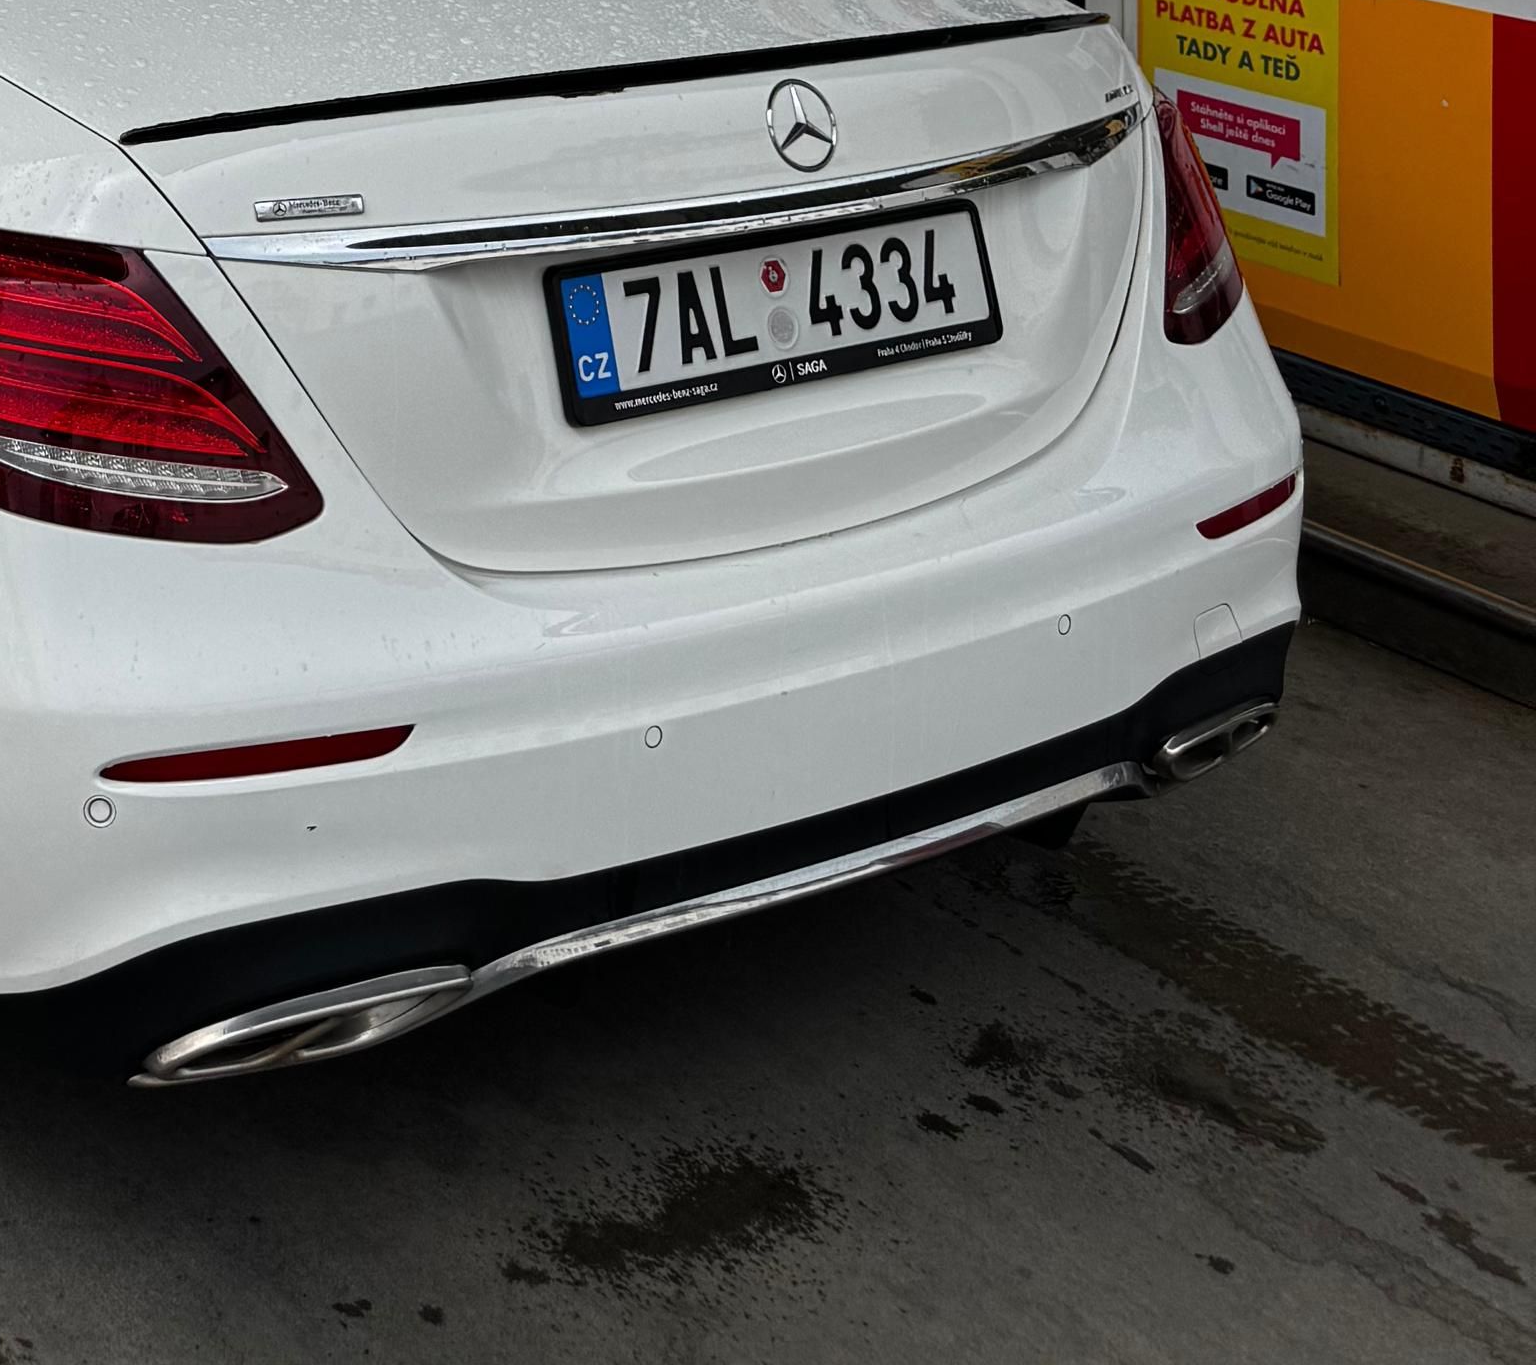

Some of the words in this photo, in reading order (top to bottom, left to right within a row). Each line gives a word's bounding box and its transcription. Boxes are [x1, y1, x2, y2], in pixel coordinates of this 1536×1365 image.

[1155, 0, 1235, 35] PLATBA
[1242, 18, 1256, 39] Z
[1263, 24, 1325, 55] AUTA
[1176, 34, 1231, 65] TADY
[1238, 50, 1254, 72] A
[1260, 54, 1301, 82] TEĎ
[1190, 101, 1234, 123] Stáhněte
[1236, 114, 1245, 125] si
[1246, 117, 1286, 136] aplikaci
[1200, 119, 1224, 135] Shell
[1225, 126, 1249, 142] ještě
[1252, 131, 1276, 148] dnes
[1266, 188, 1294, 207] Google
[622, 265, 760, 374] 7AL
[808, 229, 956, 337] 4334
[577, 352, 612, 382] CZ
[797, 359, 827, 376] SAGA
